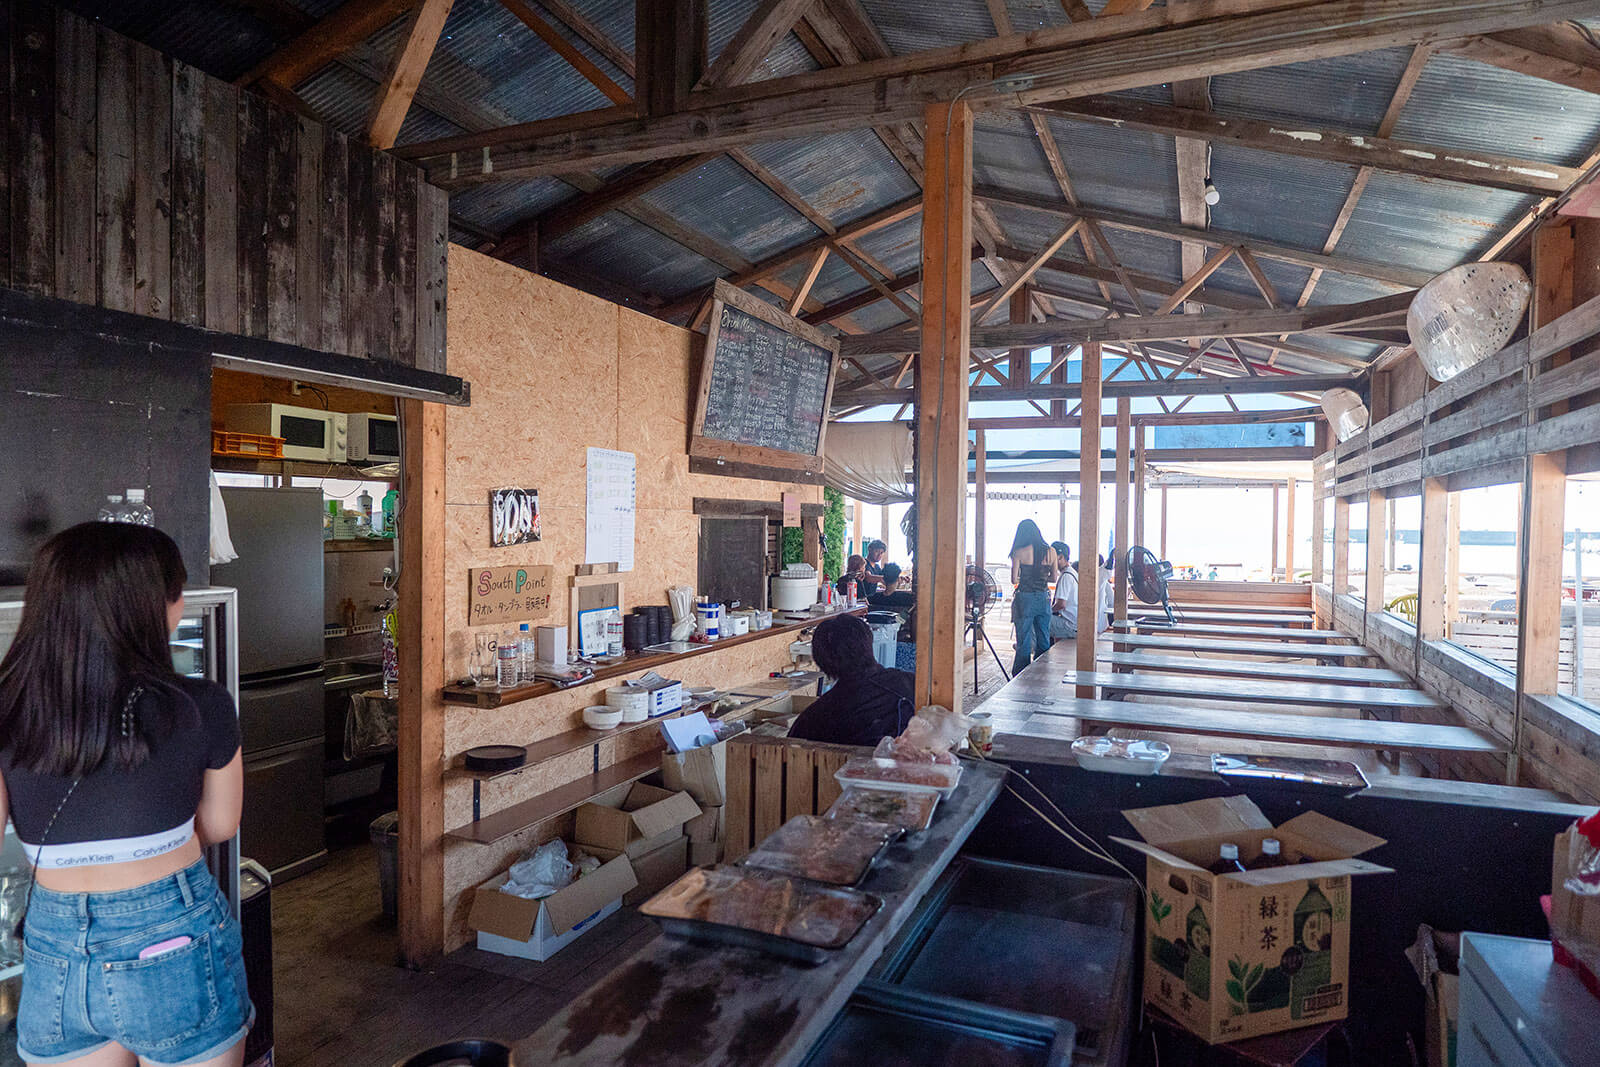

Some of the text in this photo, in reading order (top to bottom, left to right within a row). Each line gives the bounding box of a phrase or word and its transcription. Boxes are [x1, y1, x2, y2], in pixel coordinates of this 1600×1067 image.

[478, 569, 546, 596] South Point
[1258, 895, 1280, 952] 緑茶
